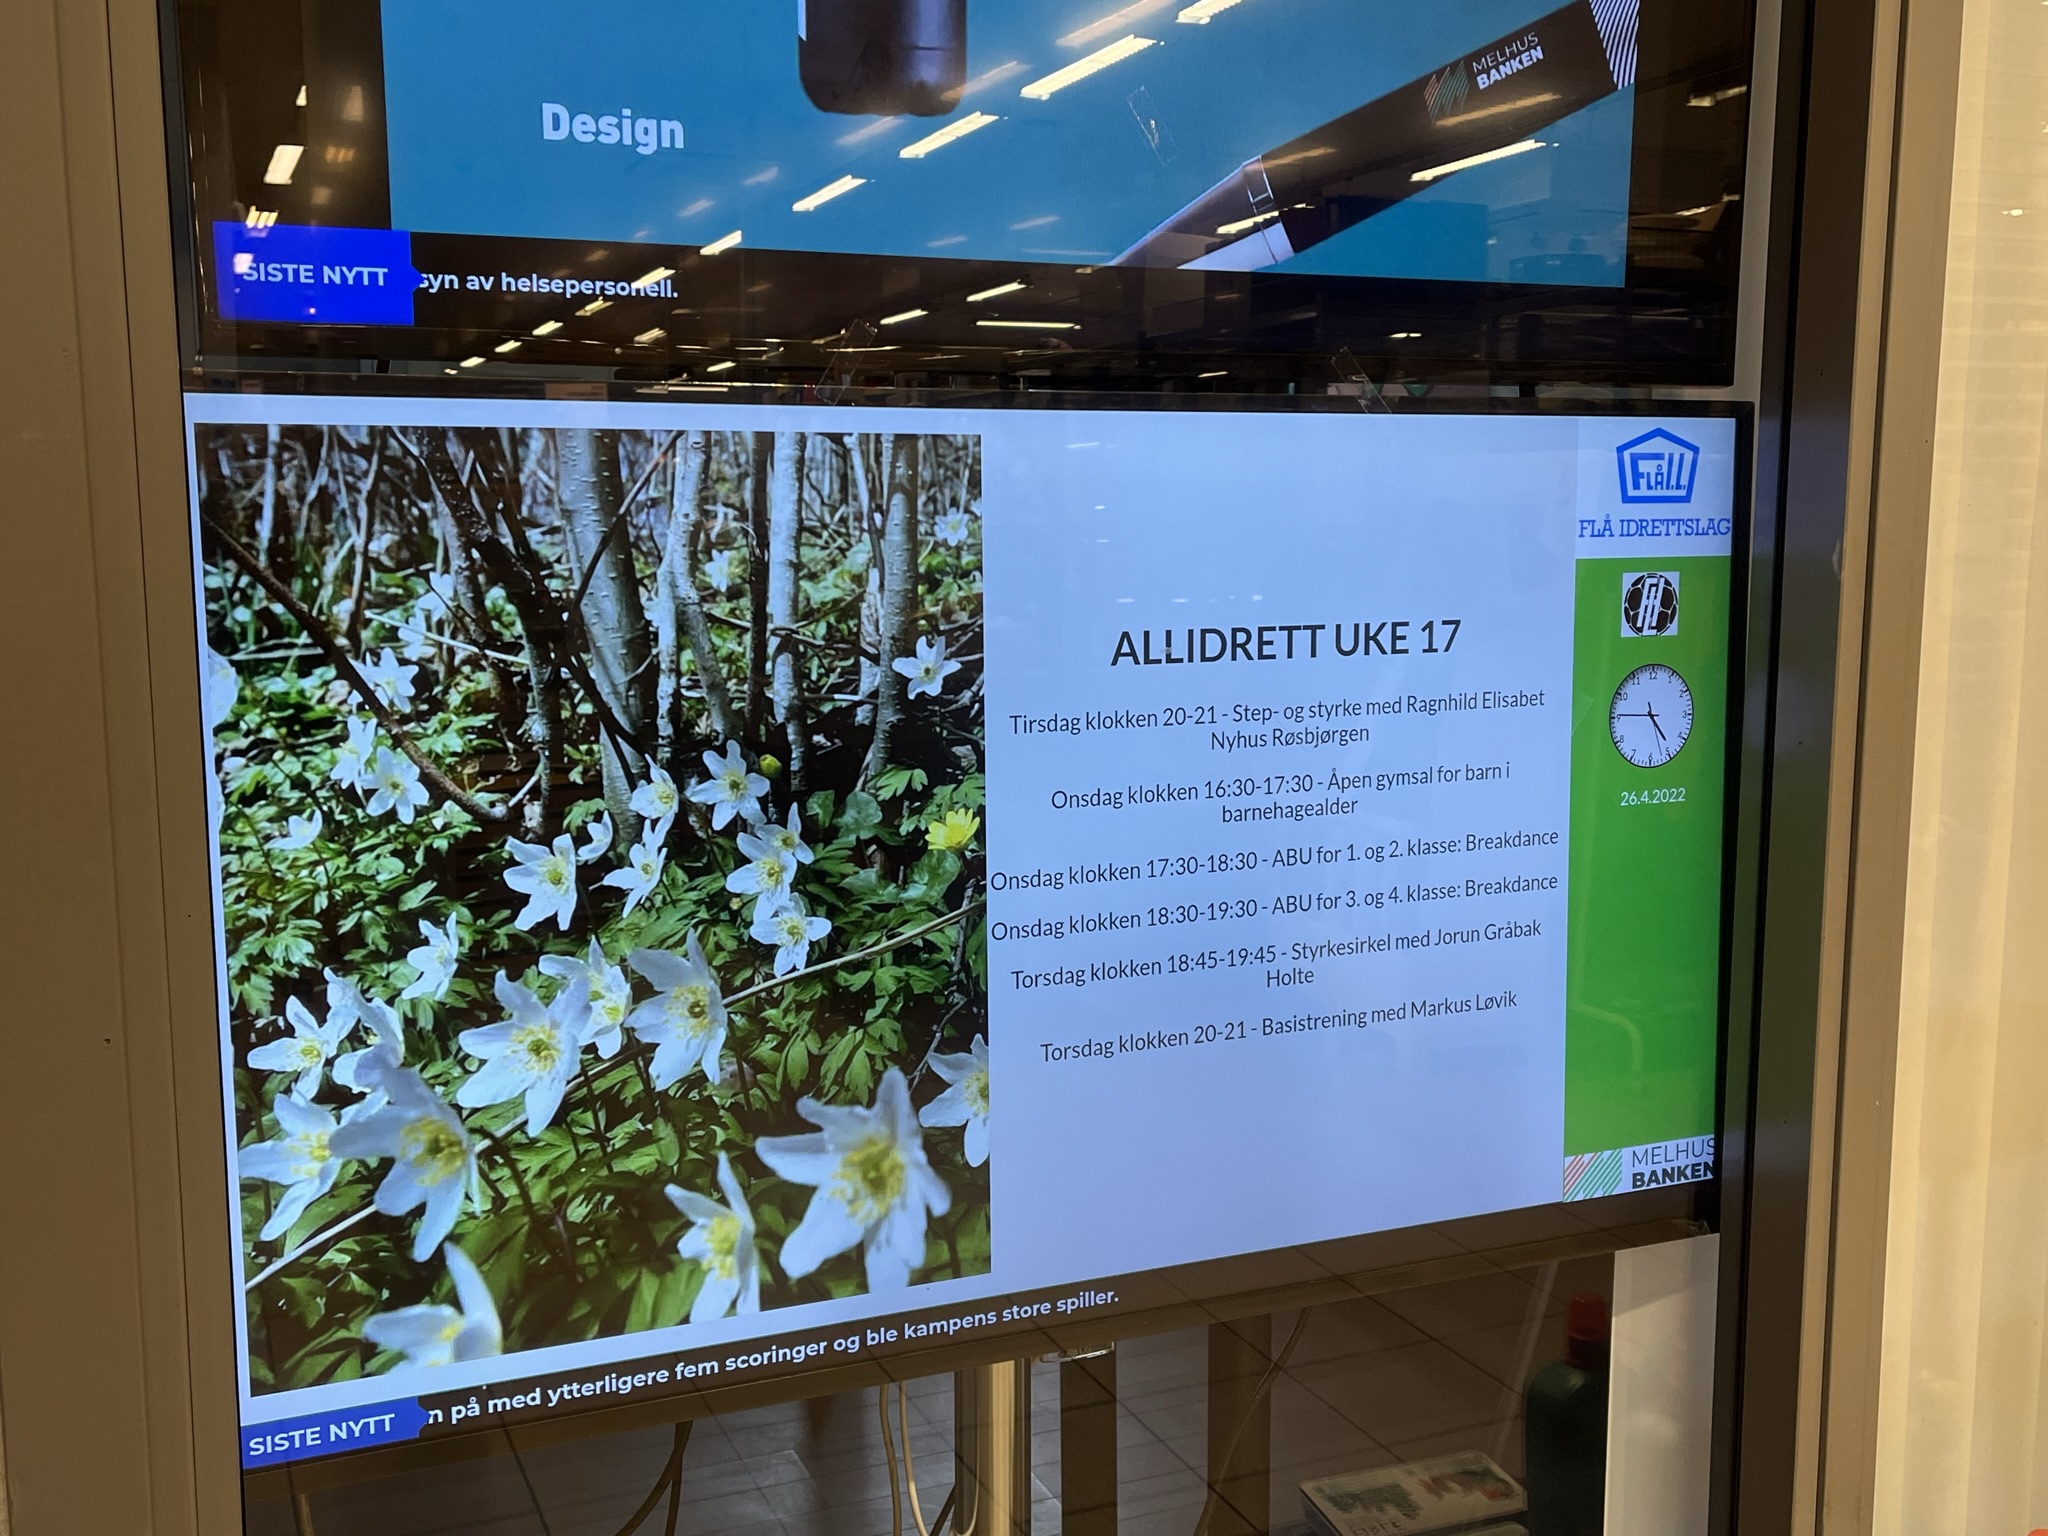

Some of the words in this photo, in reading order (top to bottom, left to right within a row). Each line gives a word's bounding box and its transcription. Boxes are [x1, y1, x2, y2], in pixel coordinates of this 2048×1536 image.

[1472, 32, 1539, 74] MELHUS
[1476, 46, 1544, 90] BANKEN
[541, 102, 685, 155] Design
[243, 262, 315, 283] SISTE
[322, 266, 388, 287] NYTT
[466, 275, 494, 290] av
[501, 272, 678, 298] helsepersonell.
[1578, 513, 1615, 538] FLÅ
[1618, 517, 1732, 537] IDRETTSLAG
[1110, 623, 1327, 667] ALLIDRETT
[1334, 620, 1411, 657] UKE
[1420, 619, 1462, 654] 17
[1008, 712, 1082, 736] Tirsdag
[1085, 709, 1158, 731] klokken
[1162, 705, 1218, 727] 20-21
[1232, 703, 1281, 726] Step-
[1283, 705, 1305, 724] og
[1307, 698, 1363, 723] styrke
[1366, 695, 1402, 716] med
[1406, 691, 1478, 716] Ragnhild
[1482, 689, 1546, 710] Elisabet
[1211, 729, 1268, 754] Nyhus
[1272, 721, 1370, 749] Røsbjørgen
[1051, 787, 1124, 810] Onsdag
[1127, 782, 1199, 805] klokken
[1204, 773, 1314, 800] 16:30-17:30
[1326, 767, 1373, 794] Åpen
[1375, 765, 1433, 792] gymsal
[1436, 765, 1462, 784] for
[1465, 763, 1502, 782] barn
[1222, 792, 1359, 824] barnehagealder
[1620, 788, 1686, 806] 26.4.2022
[990, 868, 1065, 892] Onsdag
[1068, 862, 1141, 886] klokken
[1146, 851, 1258, 879] 17:30-18:30
[1271, 846, 1313, 869] ABU
[1315, 845, 1343, 865] for
[1346, 843, 1361, 862] 1.
[1364, 845, 1386, 863] og
[1388, 839, 1404, 859] 2.
[1407, 837, 1462, 857] klasse:
[1465, 830, 1559, 852] Breakdance
[990, 917, 1066, 941] Onsdag
[1069, 911, 1141, 935] klokken
[1146, 898, 1258, 927] 18:30-19:30
[1271, 893, 1312, 916] ABU
[1315, 892, 1342, 912] for
[1345, 889, 1361, 908] 3.
[1363, 891, 1385, 910] og
[1387, 885, 1404, 904] 4.
[1406, 883, 1461, 903] klasse:
[1465, 874, 1558, 898] Breakdance
[1010, 965, 1087, 990] Torsdag
[1090, 958, 1162, 982] klokken
[1167, 944, 1277, 974] 18:45-19:45
[1291, 932, 1391, 963] Styrkesirkel
[1395, 929, 1431, 951] med
[1433, 927, 1481, 947] Jorun
[1483, 918, 1542, 941] Gråbak
[1266, 967, 1315, 989] Holte
[1039, 1038, 1115, 1063] Torsdag
[1118, 1030, 1189, 1054] klokken
[1193, 1020, 1247, 1045] 20-21
[1262, 1008, 1368, 1036] Basistrening
[1371, 1001, 1407, 1024] med
[1410, 997, 1472, 1019] Markus
[1475, 990, 1518, 1011] Løvik
[1631, 1137, 1715, 1168] MELHUS
[1631, 1160, 1714, 1189] BANKEN
[451, 1396, 480, 1424] på
[488, 1389, 541, 1415] med
[547, 1368, 669, 1405] ytterligere
[674, 1358, 719, 1381] fem
[724, 1340, 828, 1372] scoringer
[833, 1333, 861, 1354] og
[866, 1326, 898, 1347] ble
[903, 1310, 997, 1341] kampens
[1002, 1300, 1052, 1323] store
[1056, 1288, 1119, 1315] spiller.
[249, 1427, 321, 1456] SISTE
[329, 1413, 395, 1443] NYTT
